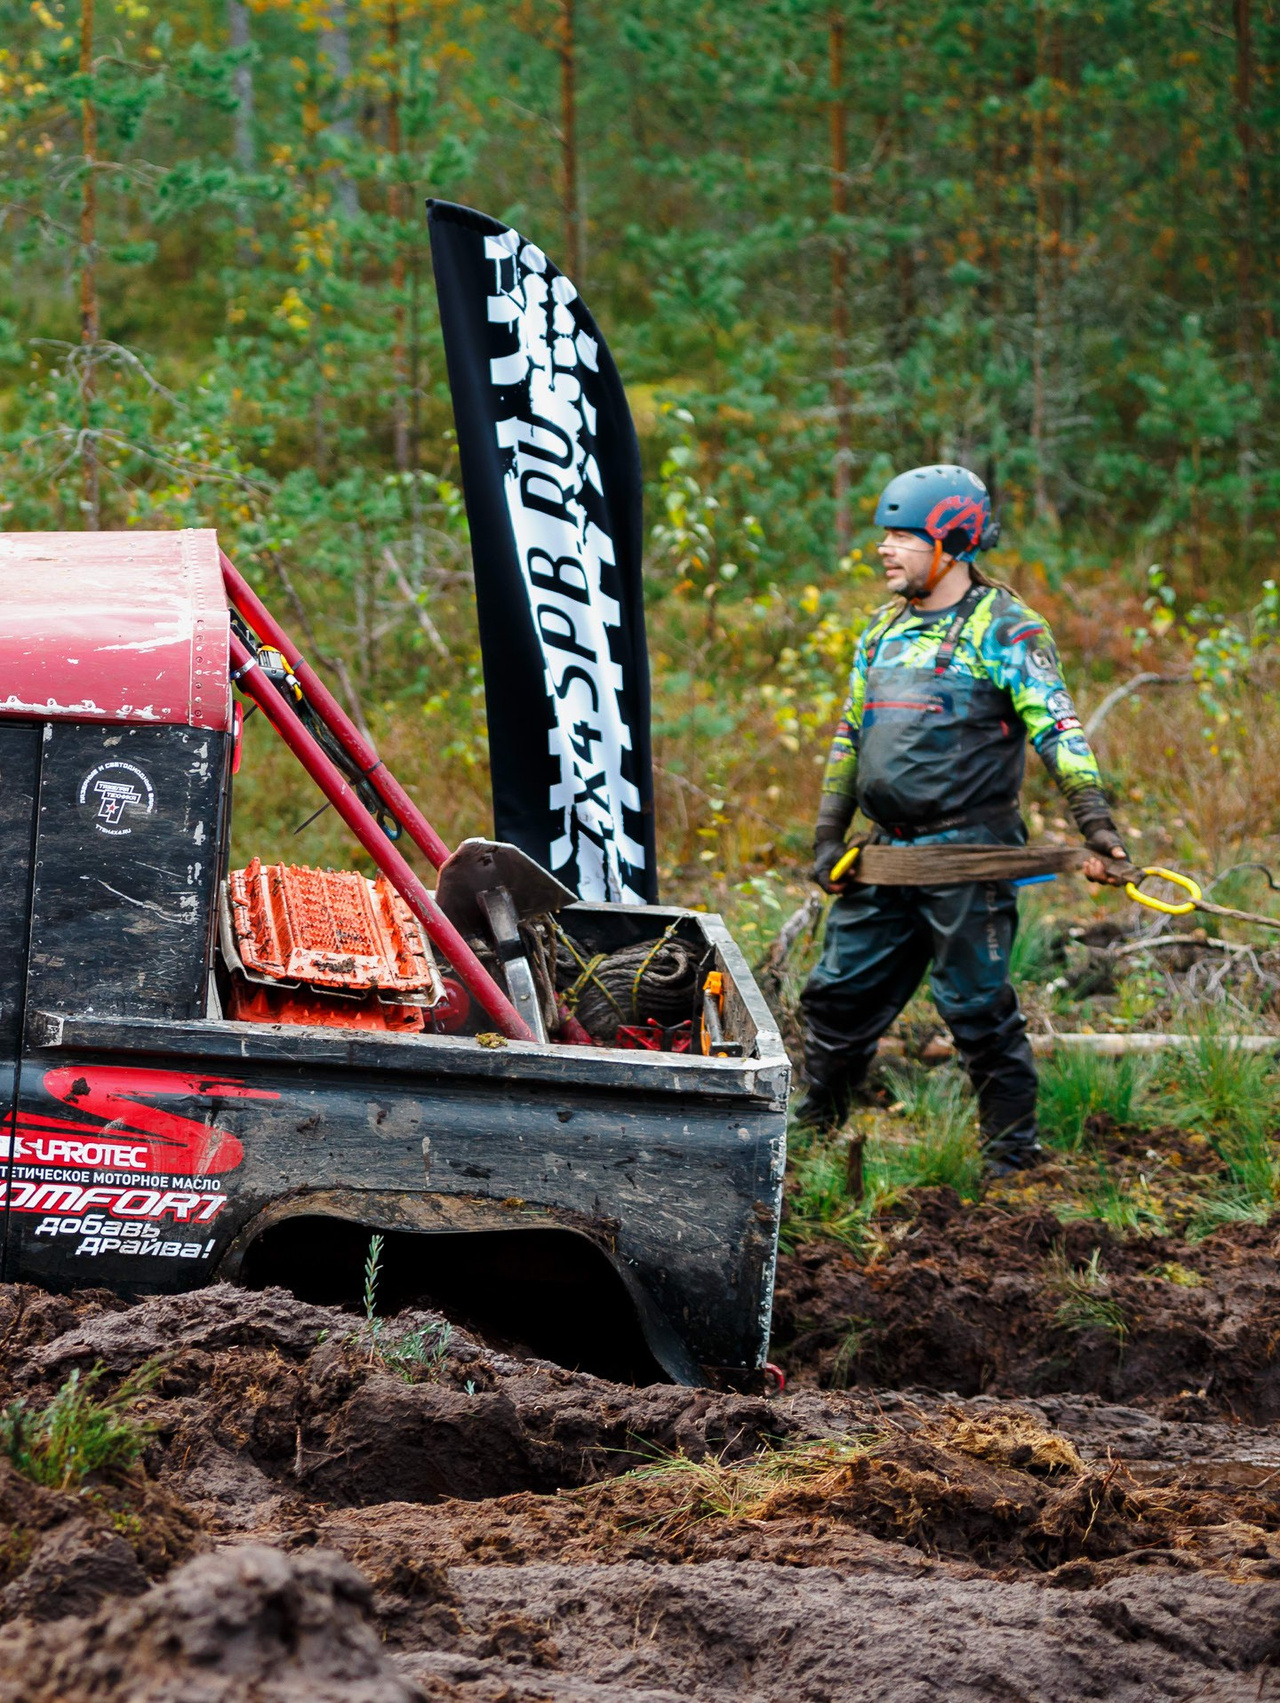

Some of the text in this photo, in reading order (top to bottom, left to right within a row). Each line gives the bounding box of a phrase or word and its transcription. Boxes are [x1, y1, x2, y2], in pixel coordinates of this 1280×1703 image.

[92, 1173, 169, 1189] МОТОРНОЕ
[171, 1177, 222, 1192] МАСЛО
[34, 1213, 161, 1239] добавь
[75, 1237, 216, 1260] драйва!
